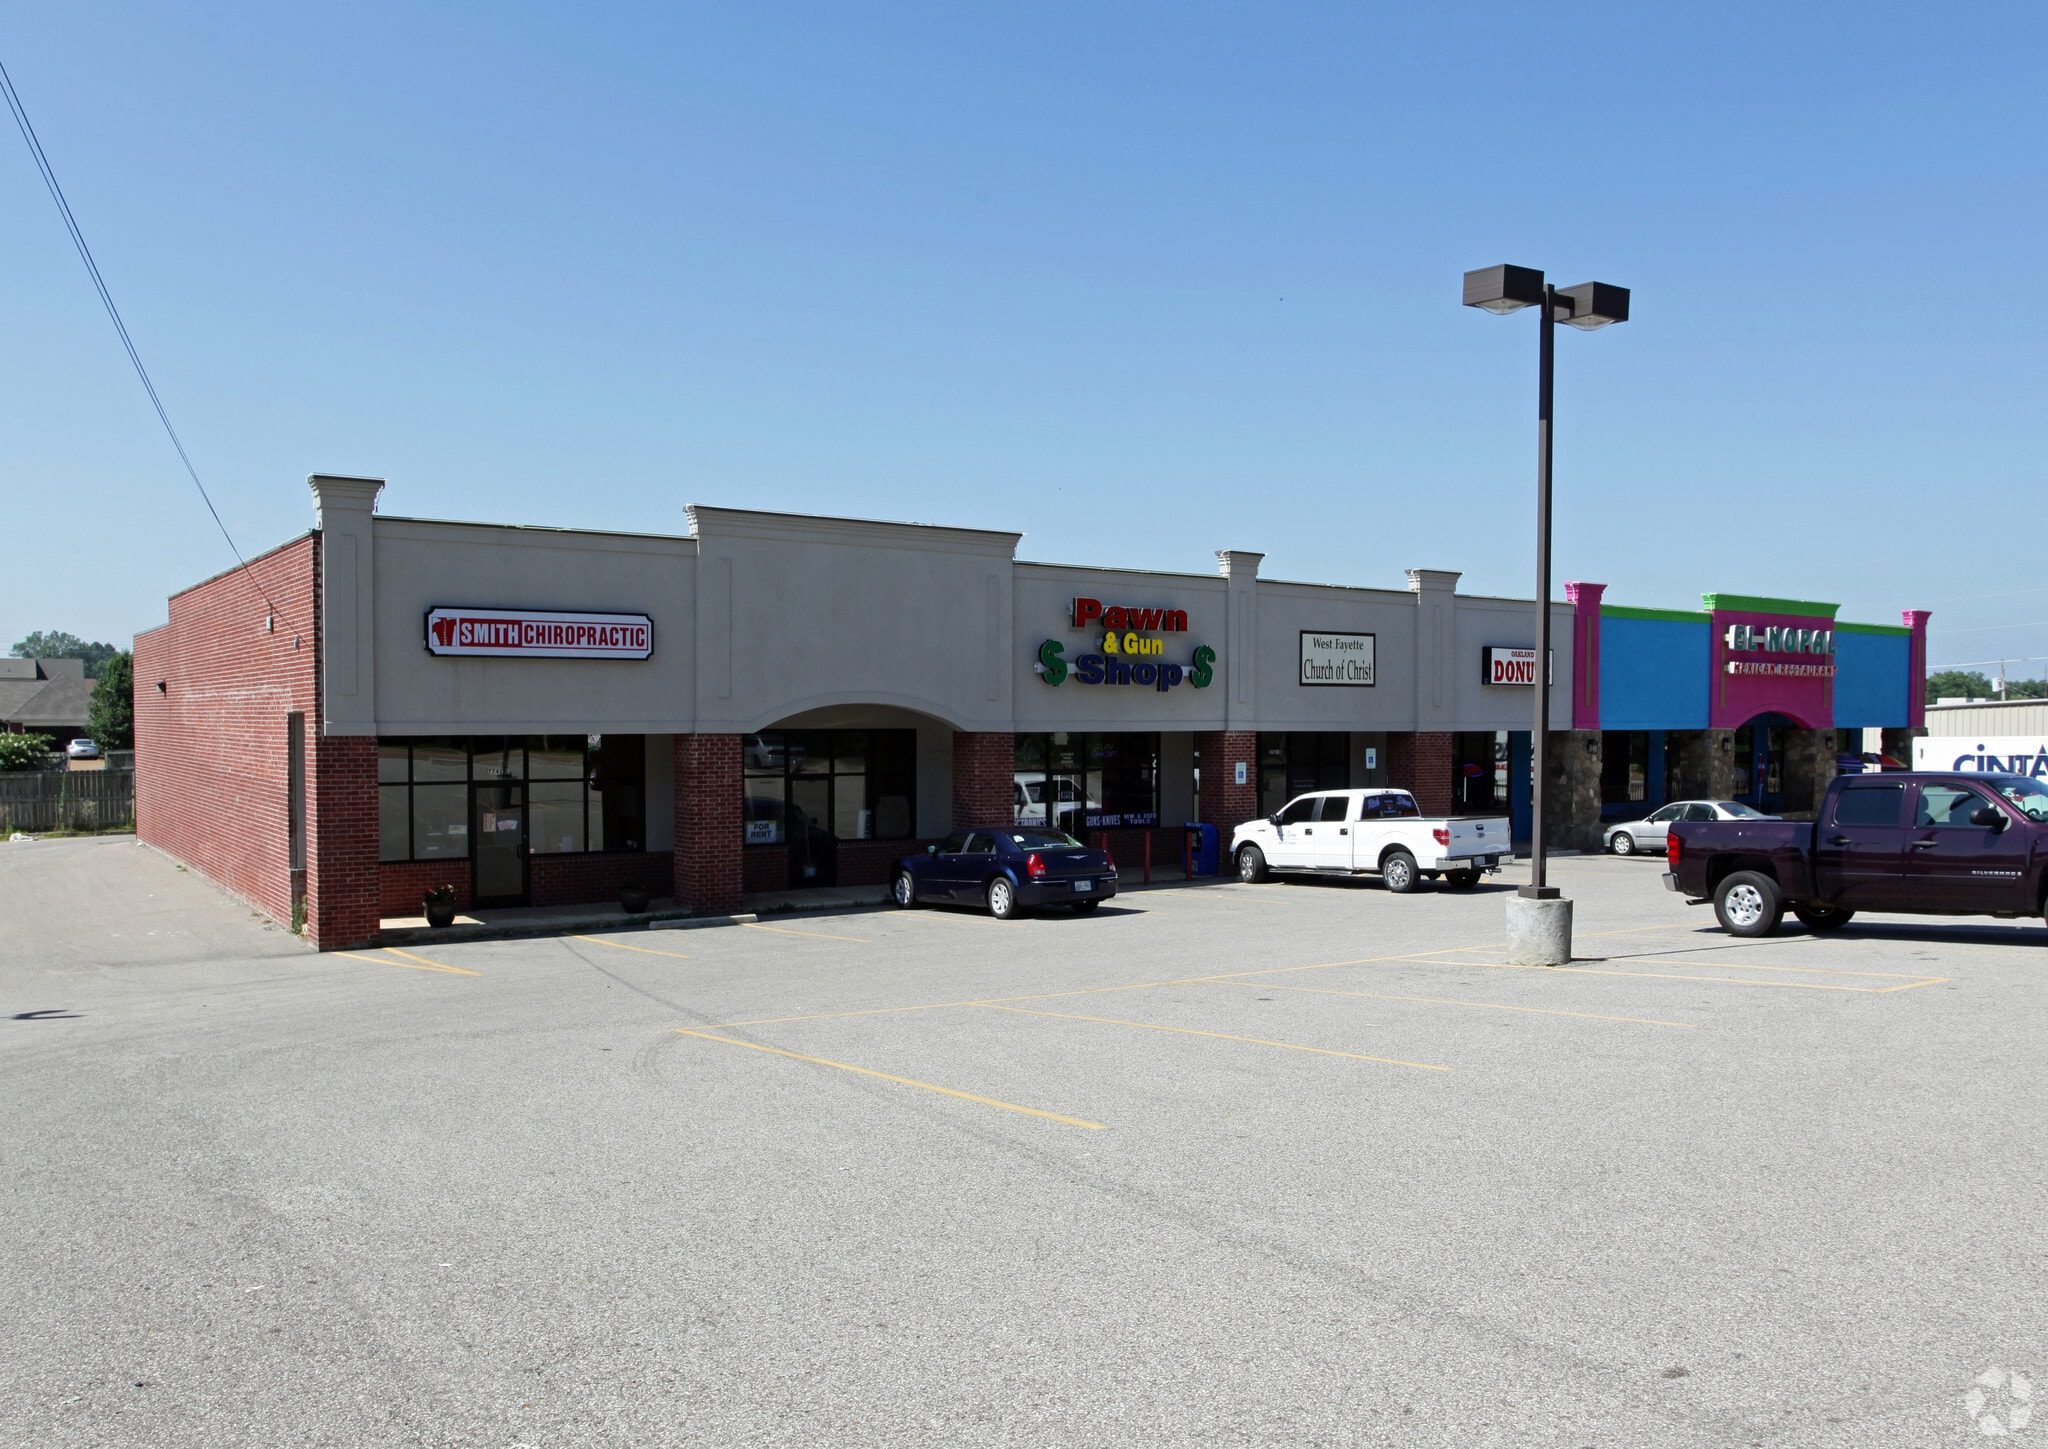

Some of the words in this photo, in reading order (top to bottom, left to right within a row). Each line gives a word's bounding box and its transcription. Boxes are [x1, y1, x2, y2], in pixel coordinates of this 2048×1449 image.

[1073, 597, 1188, 631] Pawn
[461, 622, 519, 644] SMITH
[524, 624, 646, 647] CHIROPRACTIC
[1103, 631, 1119, 654] &
[1122, 632, 1163, 654] Gun
[1313, 638, 1332, 649] West
[1335, 639, 1364, 653] Fayette
[1729, 625, 1757, 651] EL
[1765, 626, 1836, 655] NOPAL
[1076, 654, 1183, 692] Shop
[1304, 659, 1334, 680] Church
[1335, 659, 1345, 680] of
[1347, 660, 1372, 680] Christ
[1494, 660, 1536, 683] DONU
[1729, 662, 1776, 674] MEXICAN
[1780, 664, 1837, 677] RESTAURANT
[751, 830, 771, 839] RENT
[754, 823, 770, 831] FOR
